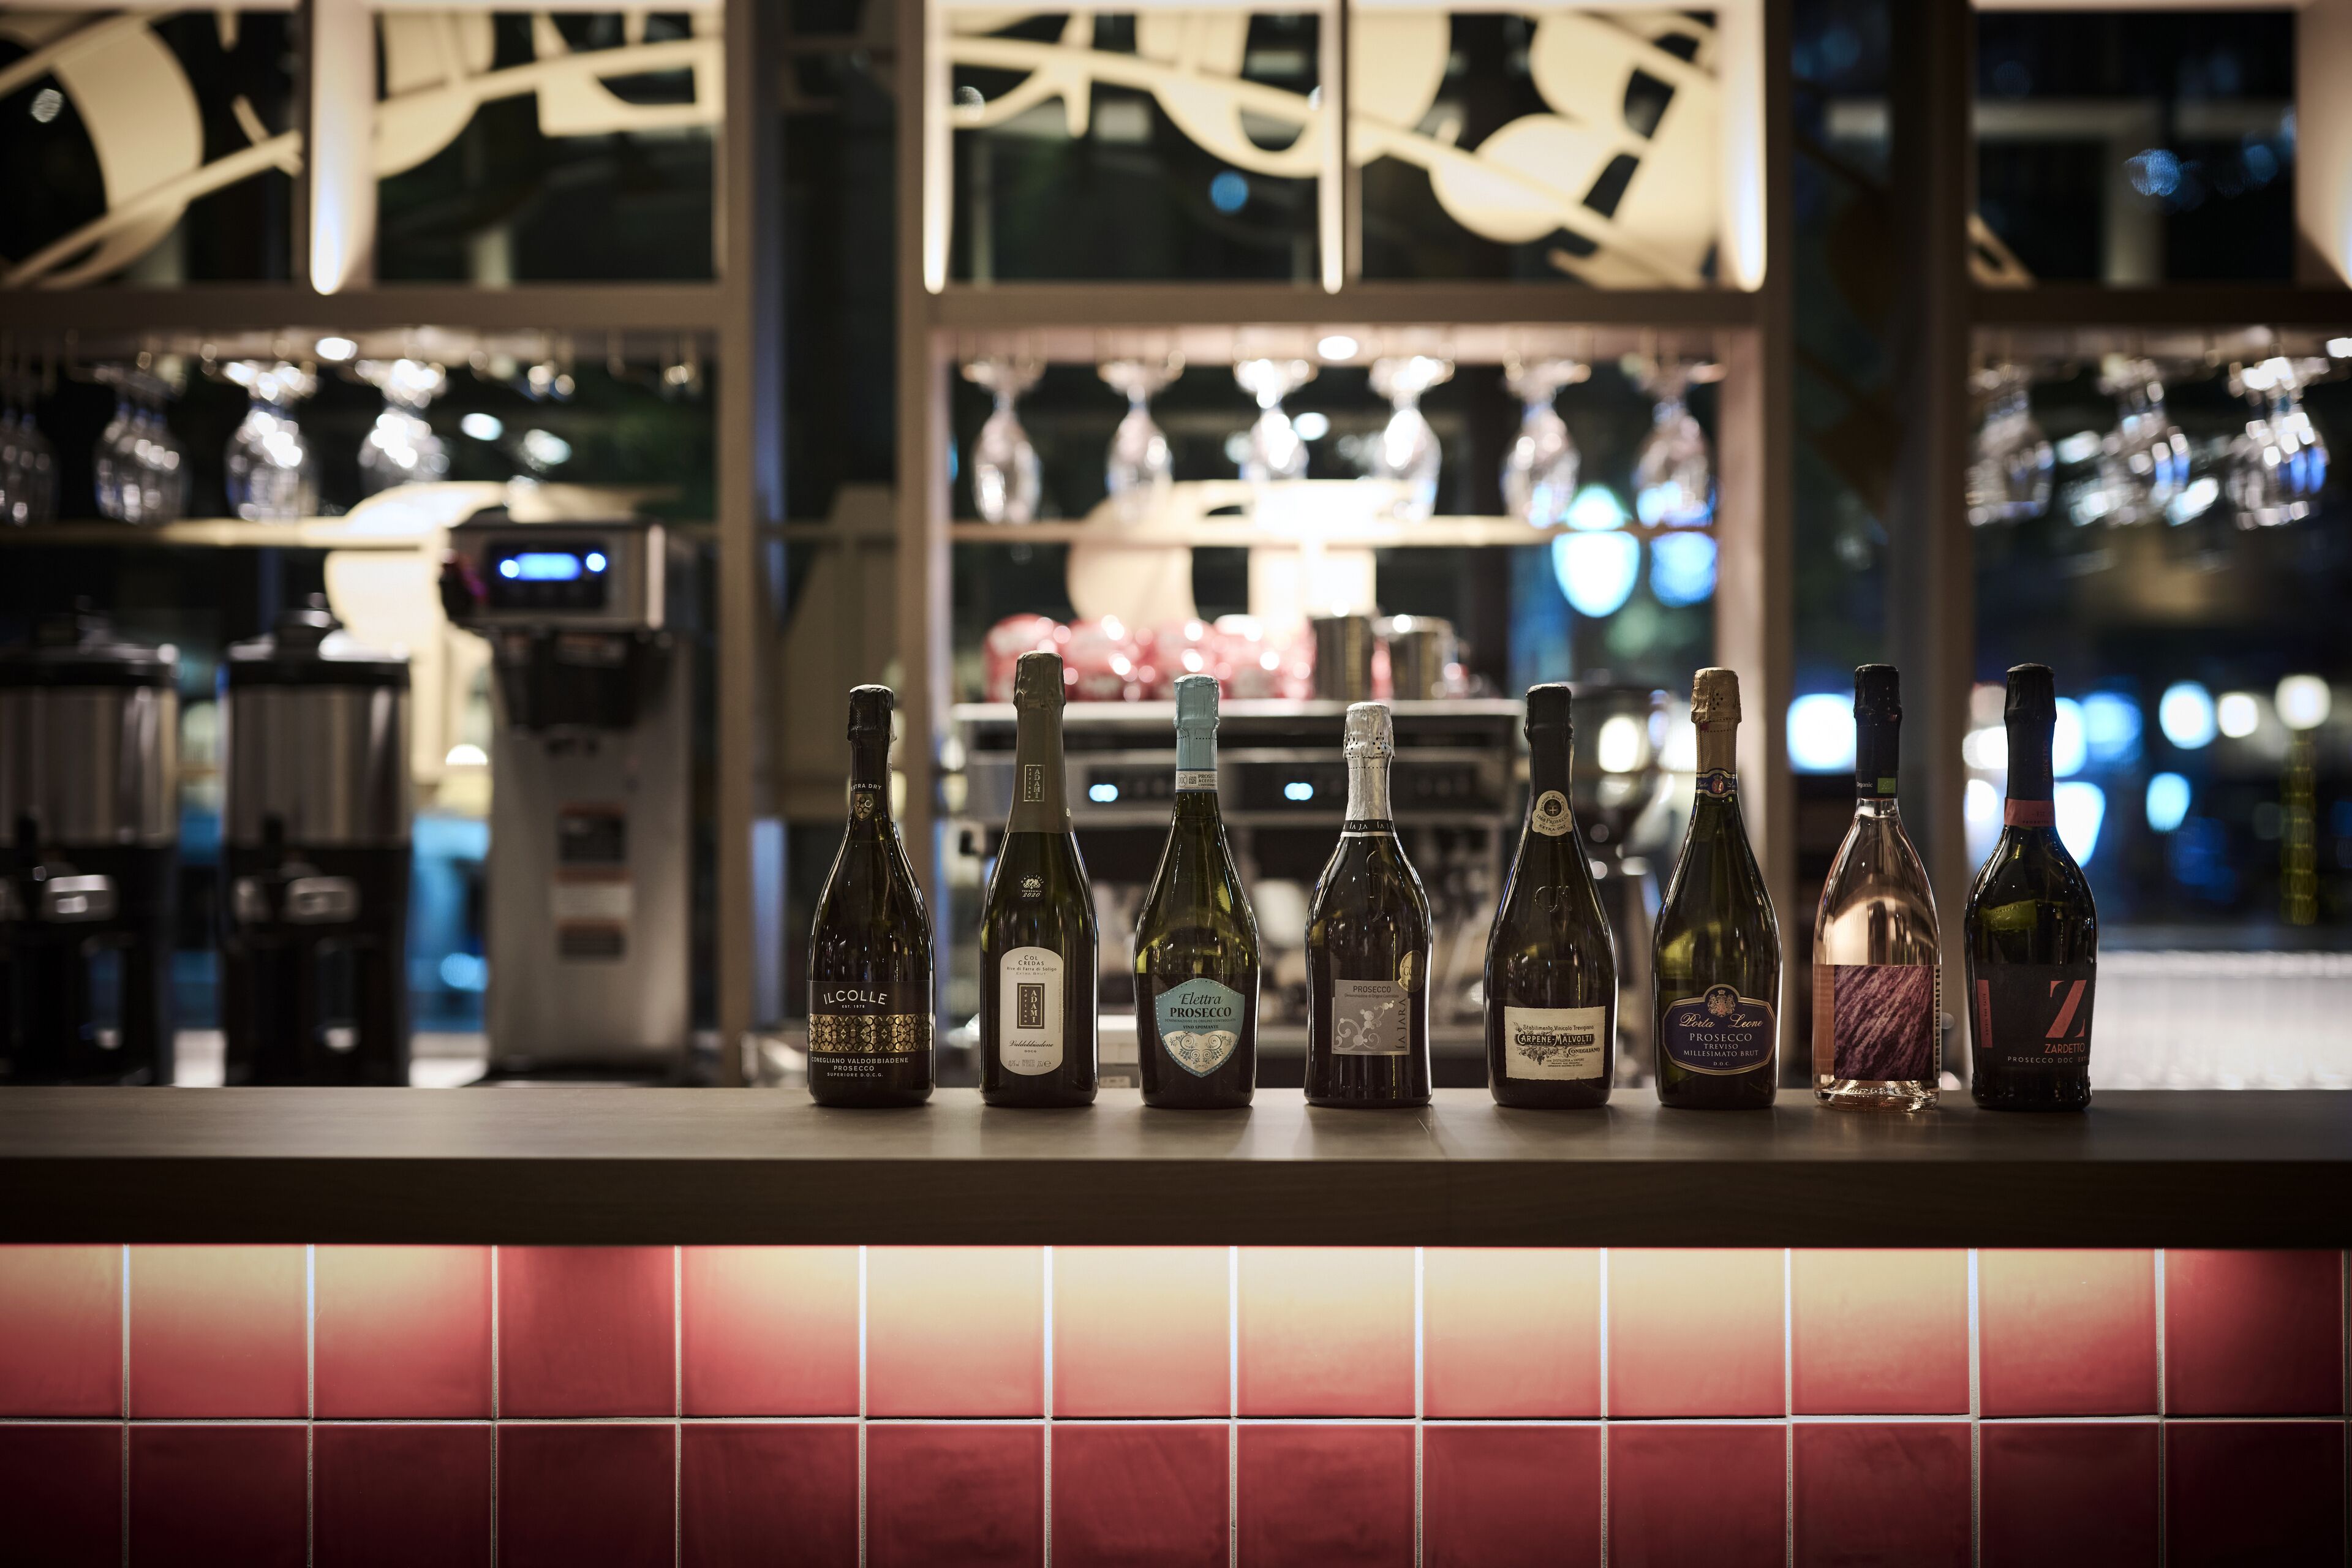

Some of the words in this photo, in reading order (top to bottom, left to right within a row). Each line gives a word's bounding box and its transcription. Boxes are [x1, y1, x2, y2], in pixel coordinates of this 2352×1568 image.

[1179, 992, 1224, 1005] Elettra
[1170, 1007, 1232, 1017] PROSECCO
[1679, 1012, 1715, 1028] Porta
[1727, 1013, 1763, 1028] Leone
[1689, 1033, 1752, 1042] PROSECCO
[1568, 1047, 1600, 1056] CONEGLIANO
[2045, 1042, 2085, 1054] ZARDETTO
